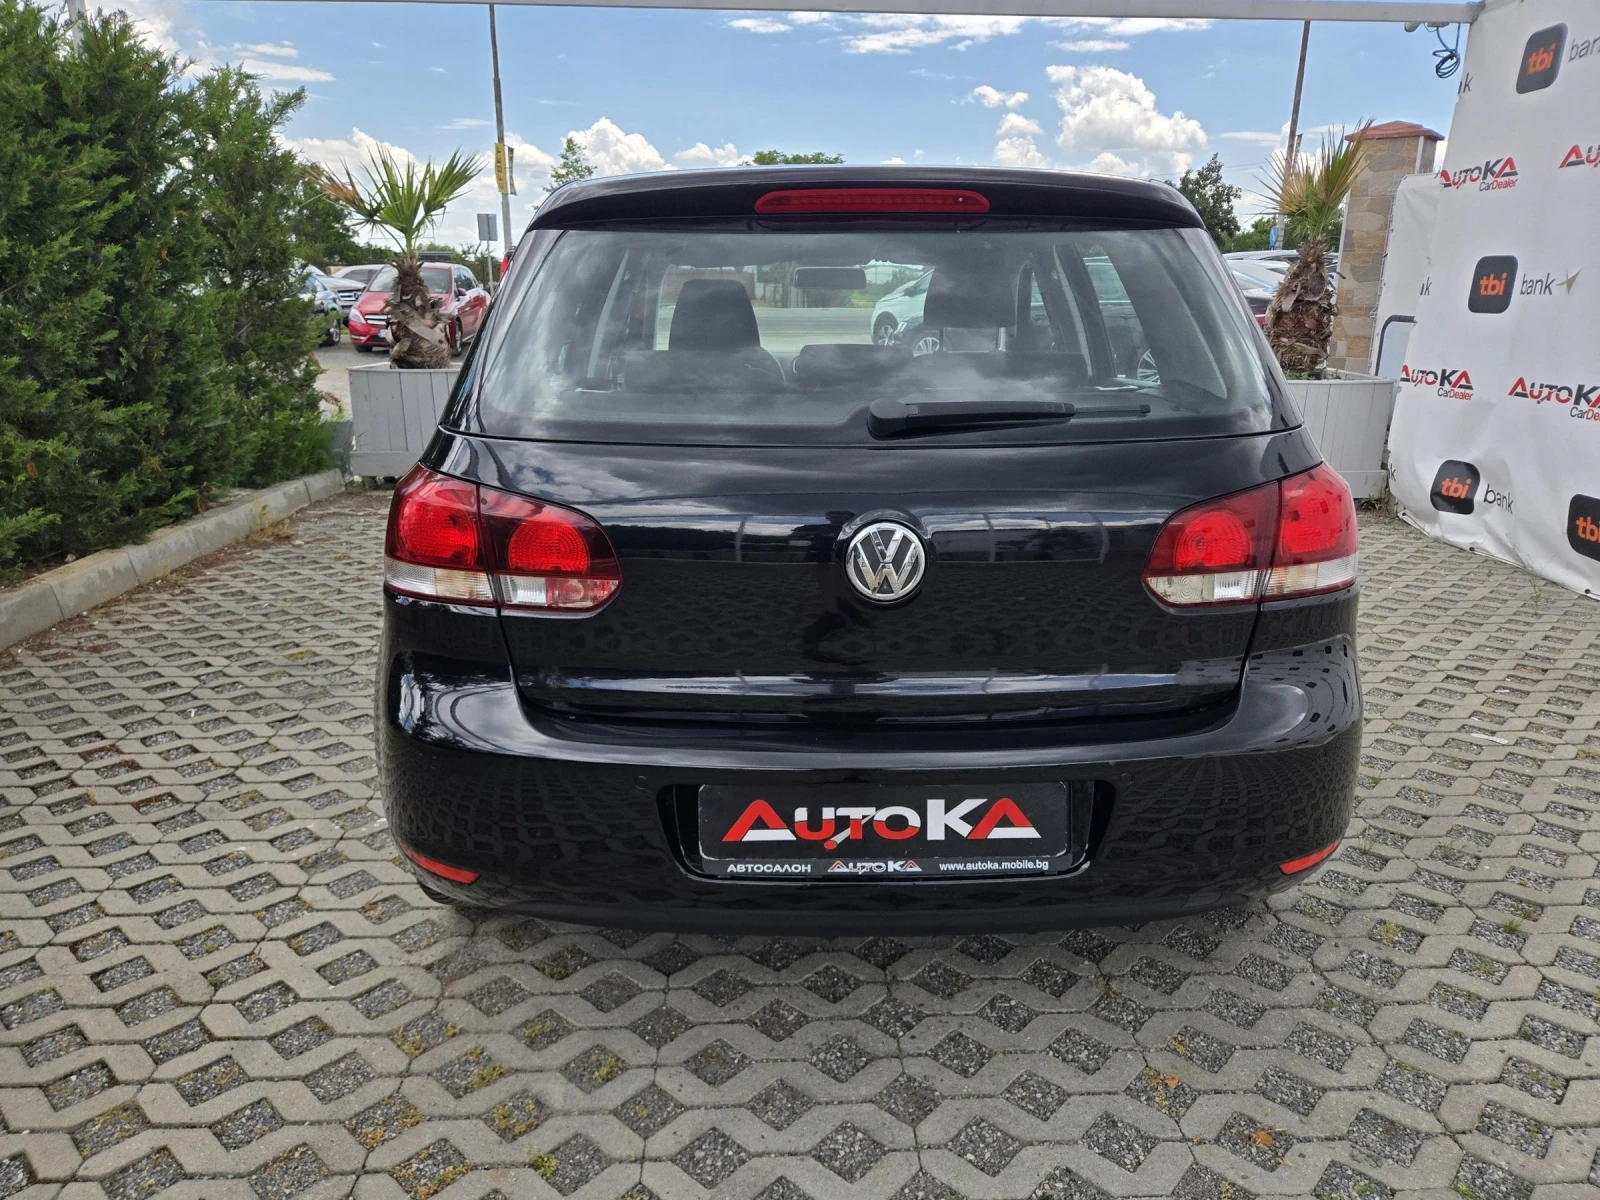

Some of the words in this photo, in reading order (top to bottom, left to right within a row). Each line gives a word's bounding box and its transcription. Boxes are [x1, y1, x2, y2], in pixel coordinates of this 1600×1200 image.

[1527, 42, 1556, 74] tbi
[1479, 177, 1518, 193] CarDealer
[1479, 272, 1508, 297] tbi
[1520, 271, 1555, 297] bank
[1437, 387, 1474, 402] CarDealer
[1440, 477, 1472, 500] tbi
[1483, 483, 1515, 515] bank
[727, 863, 812, 874] АВТОСАЛОН
[938, 859, 1050, 872] www.autoka.mobile.bg
